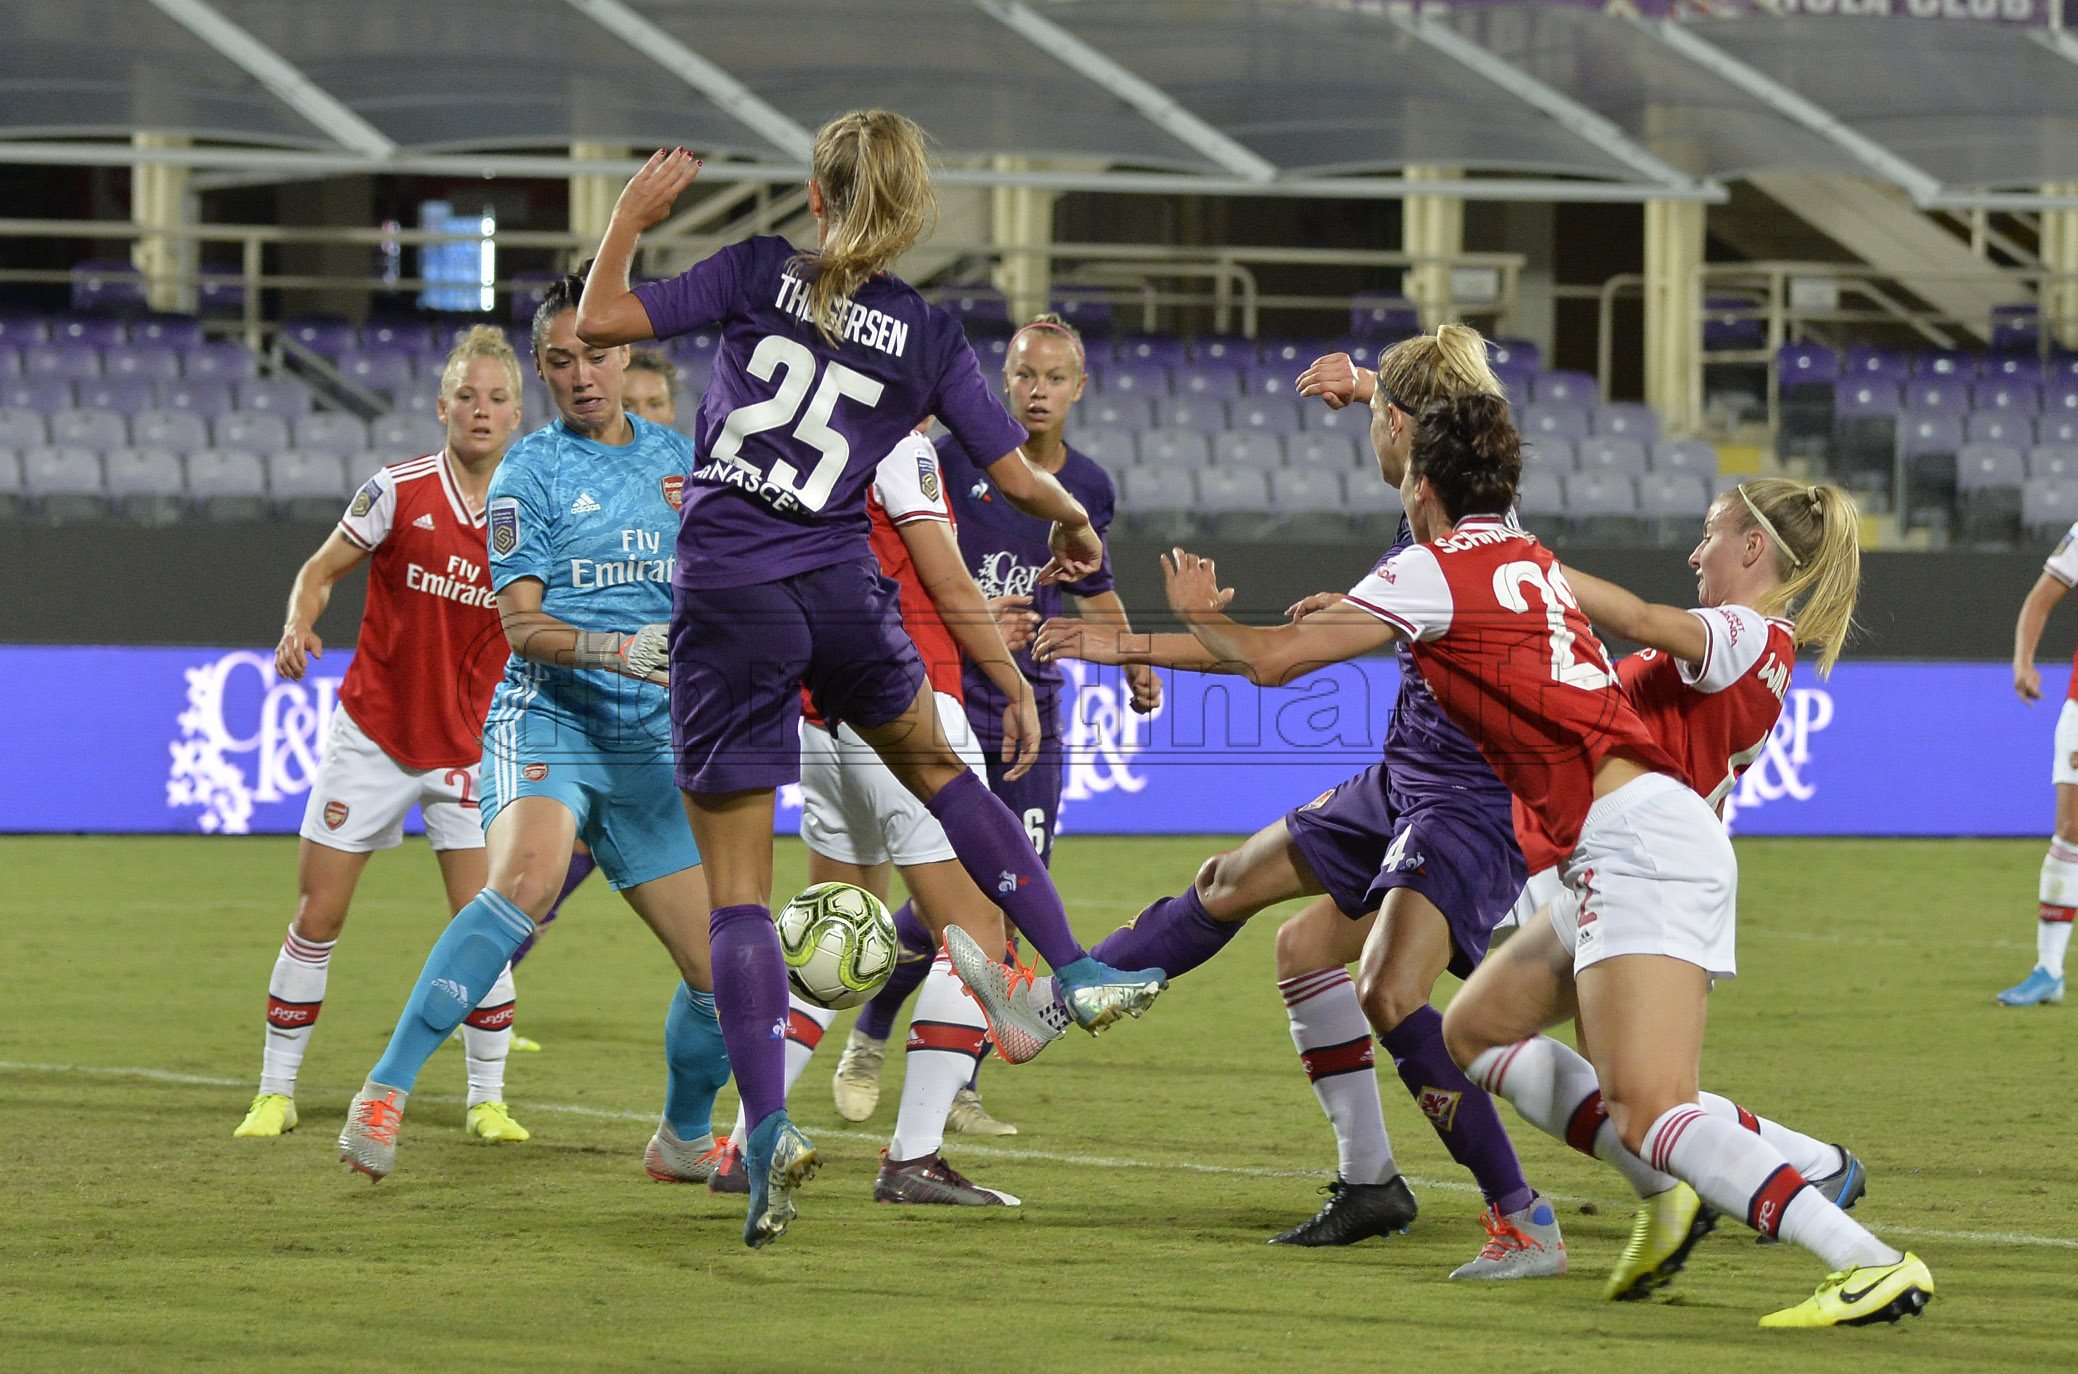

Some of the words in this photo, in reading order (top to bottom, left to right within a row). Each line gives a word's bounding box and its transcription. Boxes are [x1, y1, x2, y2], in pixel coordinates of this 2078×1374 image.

[775, 273, 908, 357] THERSEN
[711, 335, 884, 512] 25
[622, 528, 660, 555] Fly
[406, 562, 498, 609] Emirate
[447, 555, 481, 583] Fly
[570, 553, 676, 588] Emirat
[1383, 824, 1413, 873] 4
